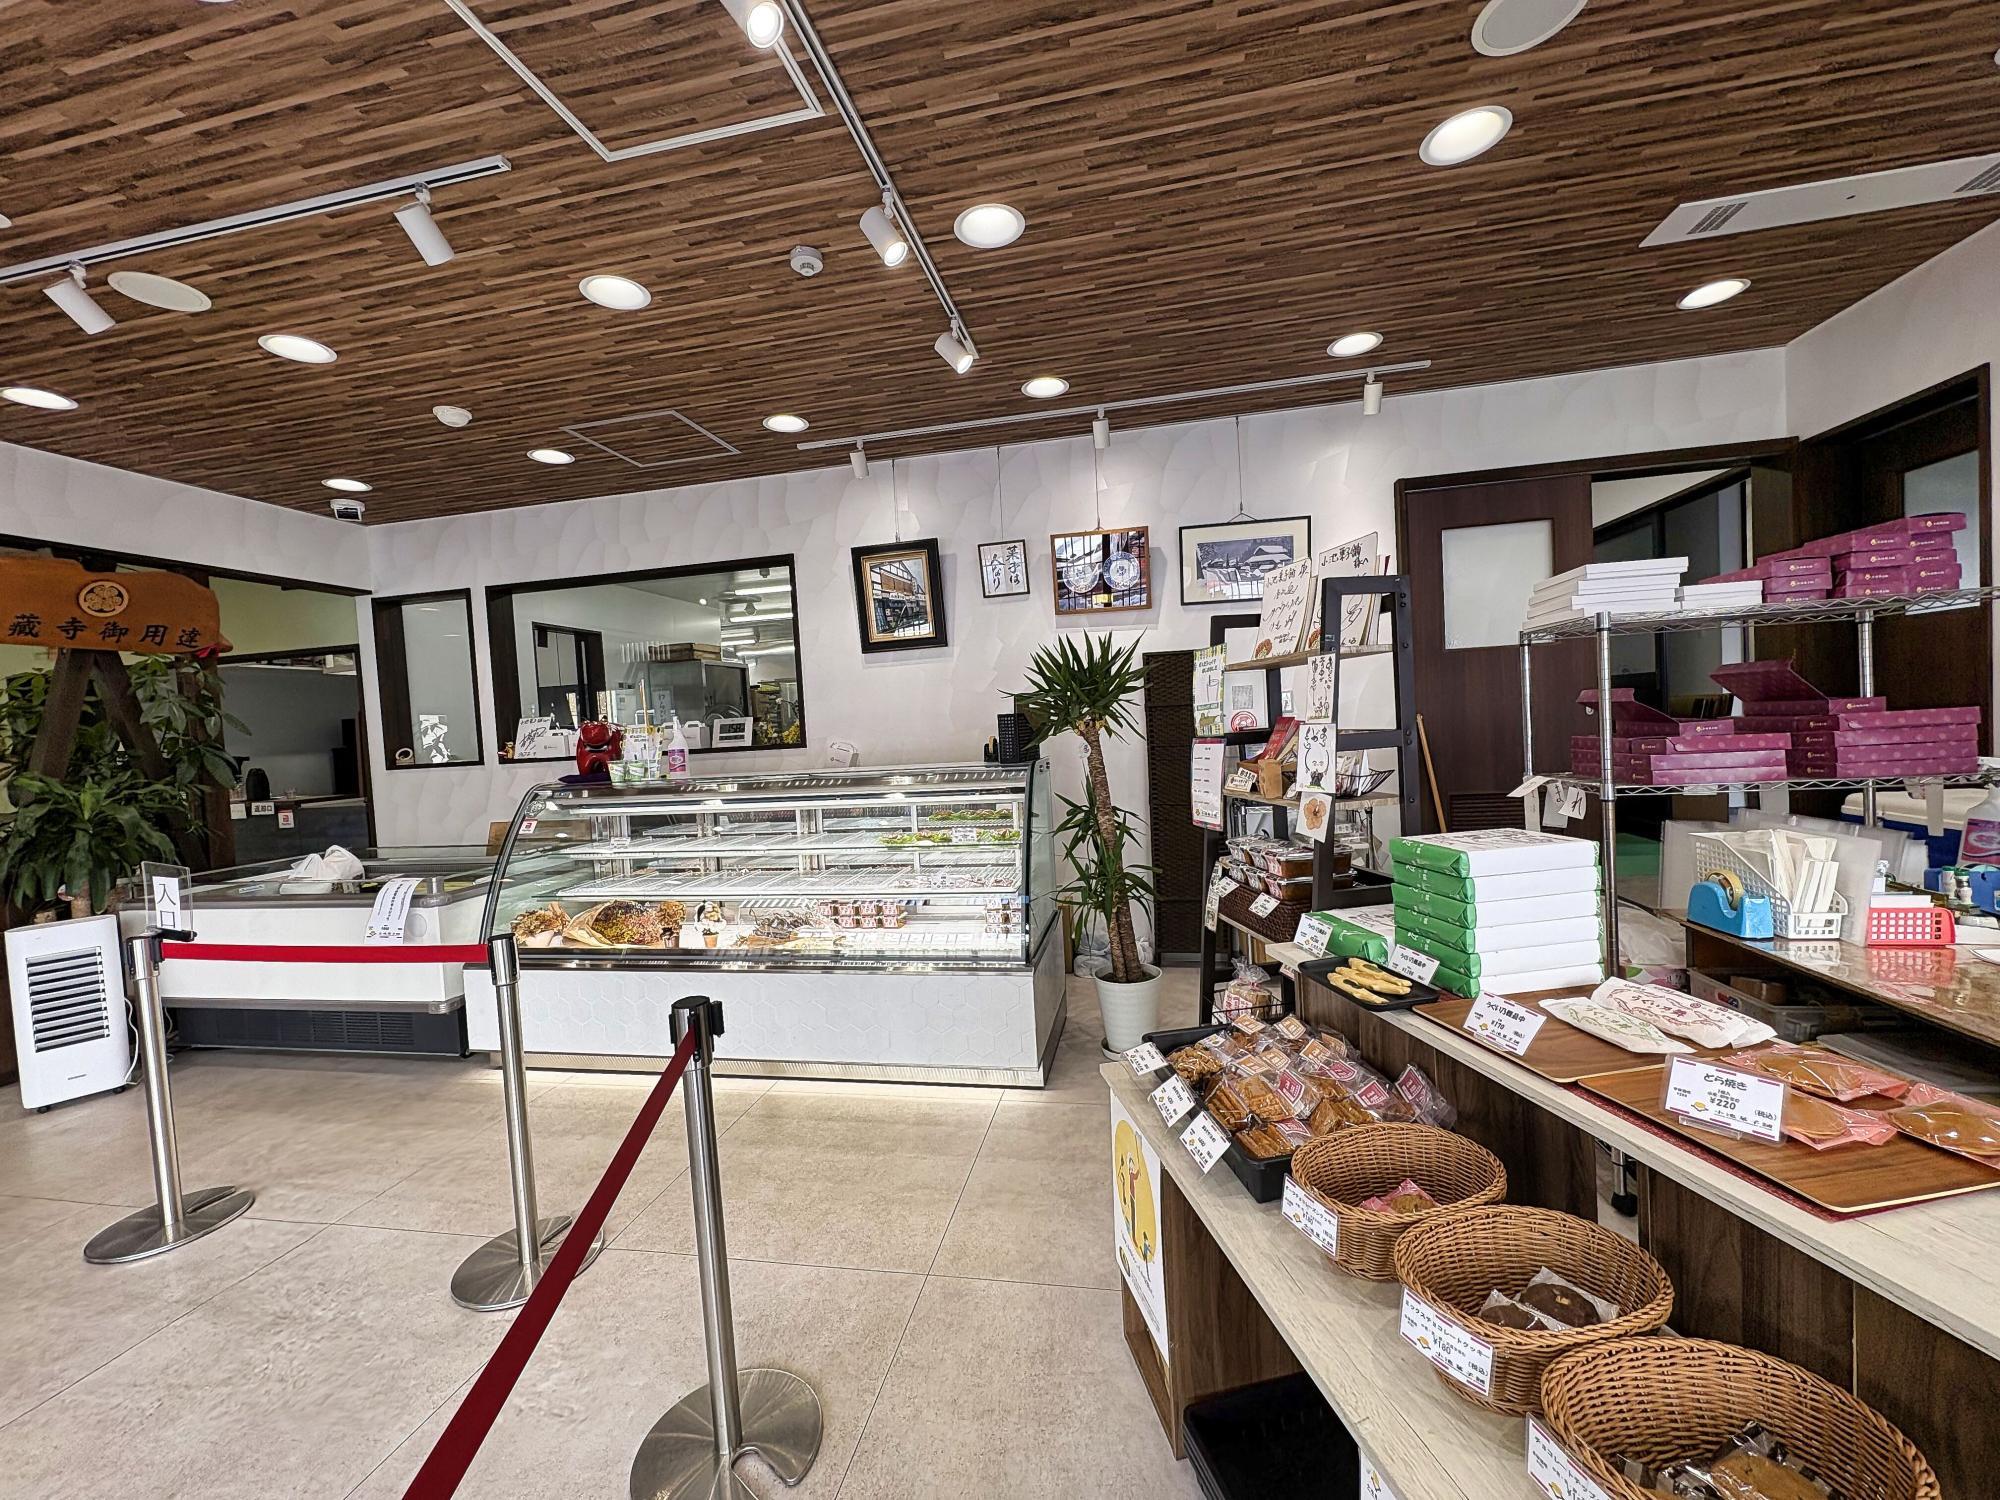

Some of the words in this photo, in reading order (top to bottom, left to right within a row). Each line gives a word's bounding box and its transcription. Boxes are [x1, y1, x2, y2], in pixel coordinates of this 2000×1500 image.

[157, 884, 176, 928] 入口
[1704, 1073, 1748, 1091] どら焼き
[1710, 1097, 1736, 1110] ¥220
[1754, 1110, 1777, 1120] (税込)
[1405, 1299, 1490, 1359] ミックスチョコレートクッキー
